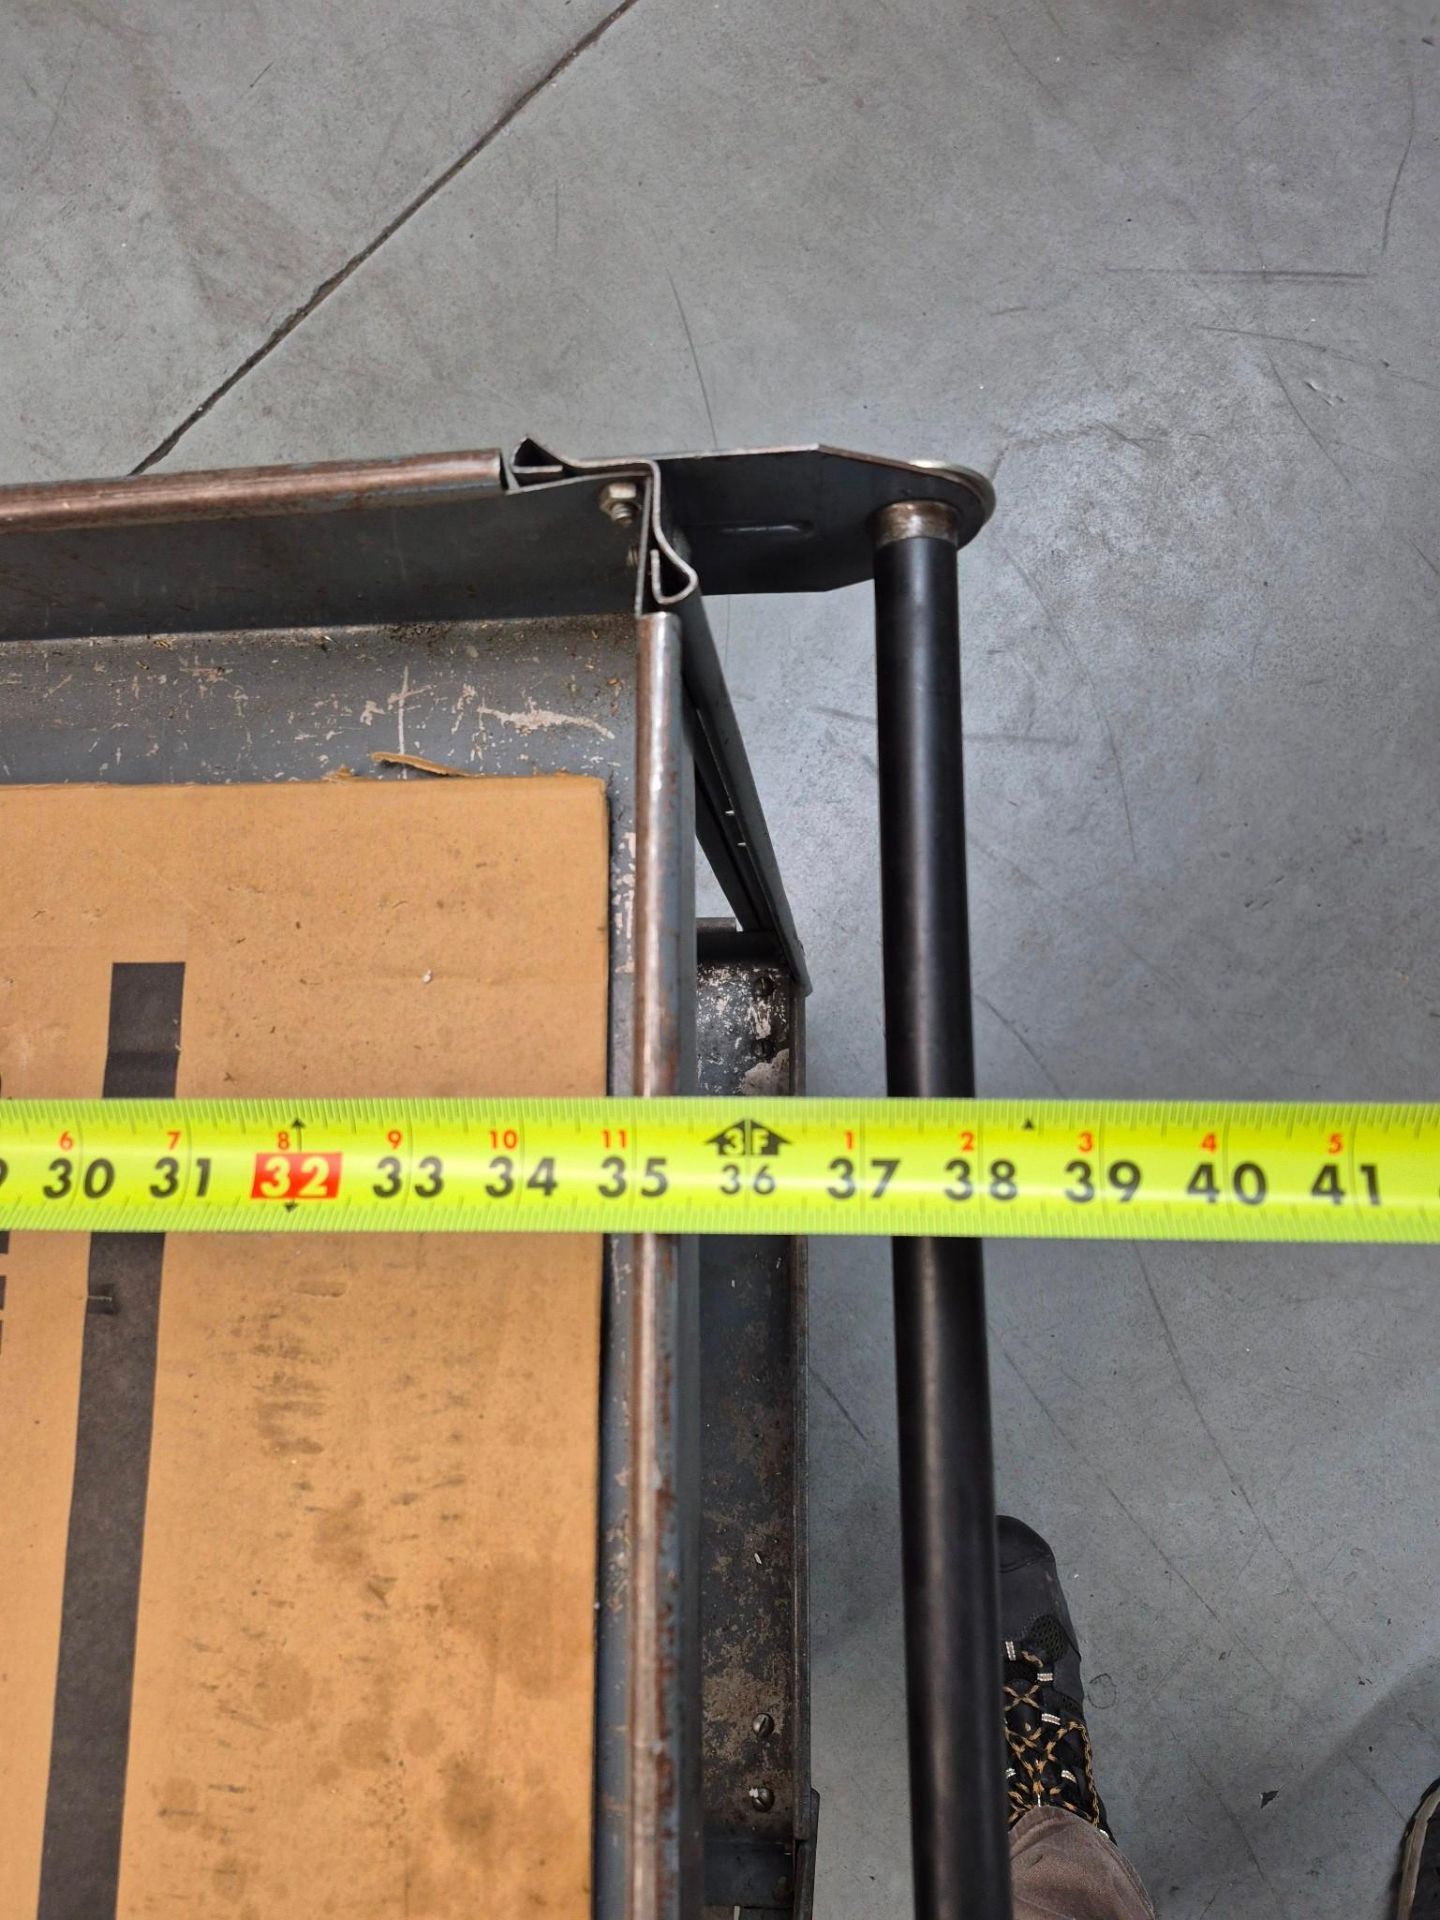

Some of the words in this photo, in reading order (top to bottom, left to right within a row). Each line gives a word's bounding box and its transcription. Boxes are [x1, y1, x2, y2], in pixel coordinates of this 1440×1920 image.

[58, 1130, 75, 1151] 6
[166, 1130, 182, 1151] 7
[276, 1130, 291, 1151] 8
[386, 1128, 403, 1150] 9
[489, 1128, 519, 1151] 10
[601, 1128, 628, 1150] 11
[722, 1127, 770, 1155] 3F
[844, 1129, 856, 1151] 1
[959, 1130, 975, 1153] 2
[1077, 1130, 1094, 1154] 3
[1200, 1131, 1218, 1153] 4
[1327, 1132, 1344, 1156] 5
[43, 1157, 114, 1199] 30
[149, 1156, 211, 1199] 31
[260, 1155, 330, 1198] 32
[372, 1156, 444, 1198] 33
[485, 1156, 557, 1198] 34
[598, 1156, 669, 1198] 35
[720, 1163, 776, 1195] 36
[827, 1158, 900, 1200] 37
[944, 1159, 1018, 1201] 38
[1066, 1160, 1141, 1203] 39
[1186, 1161, 1267, 1206] 40
[1311, 1163, 1382, 1206] 41
